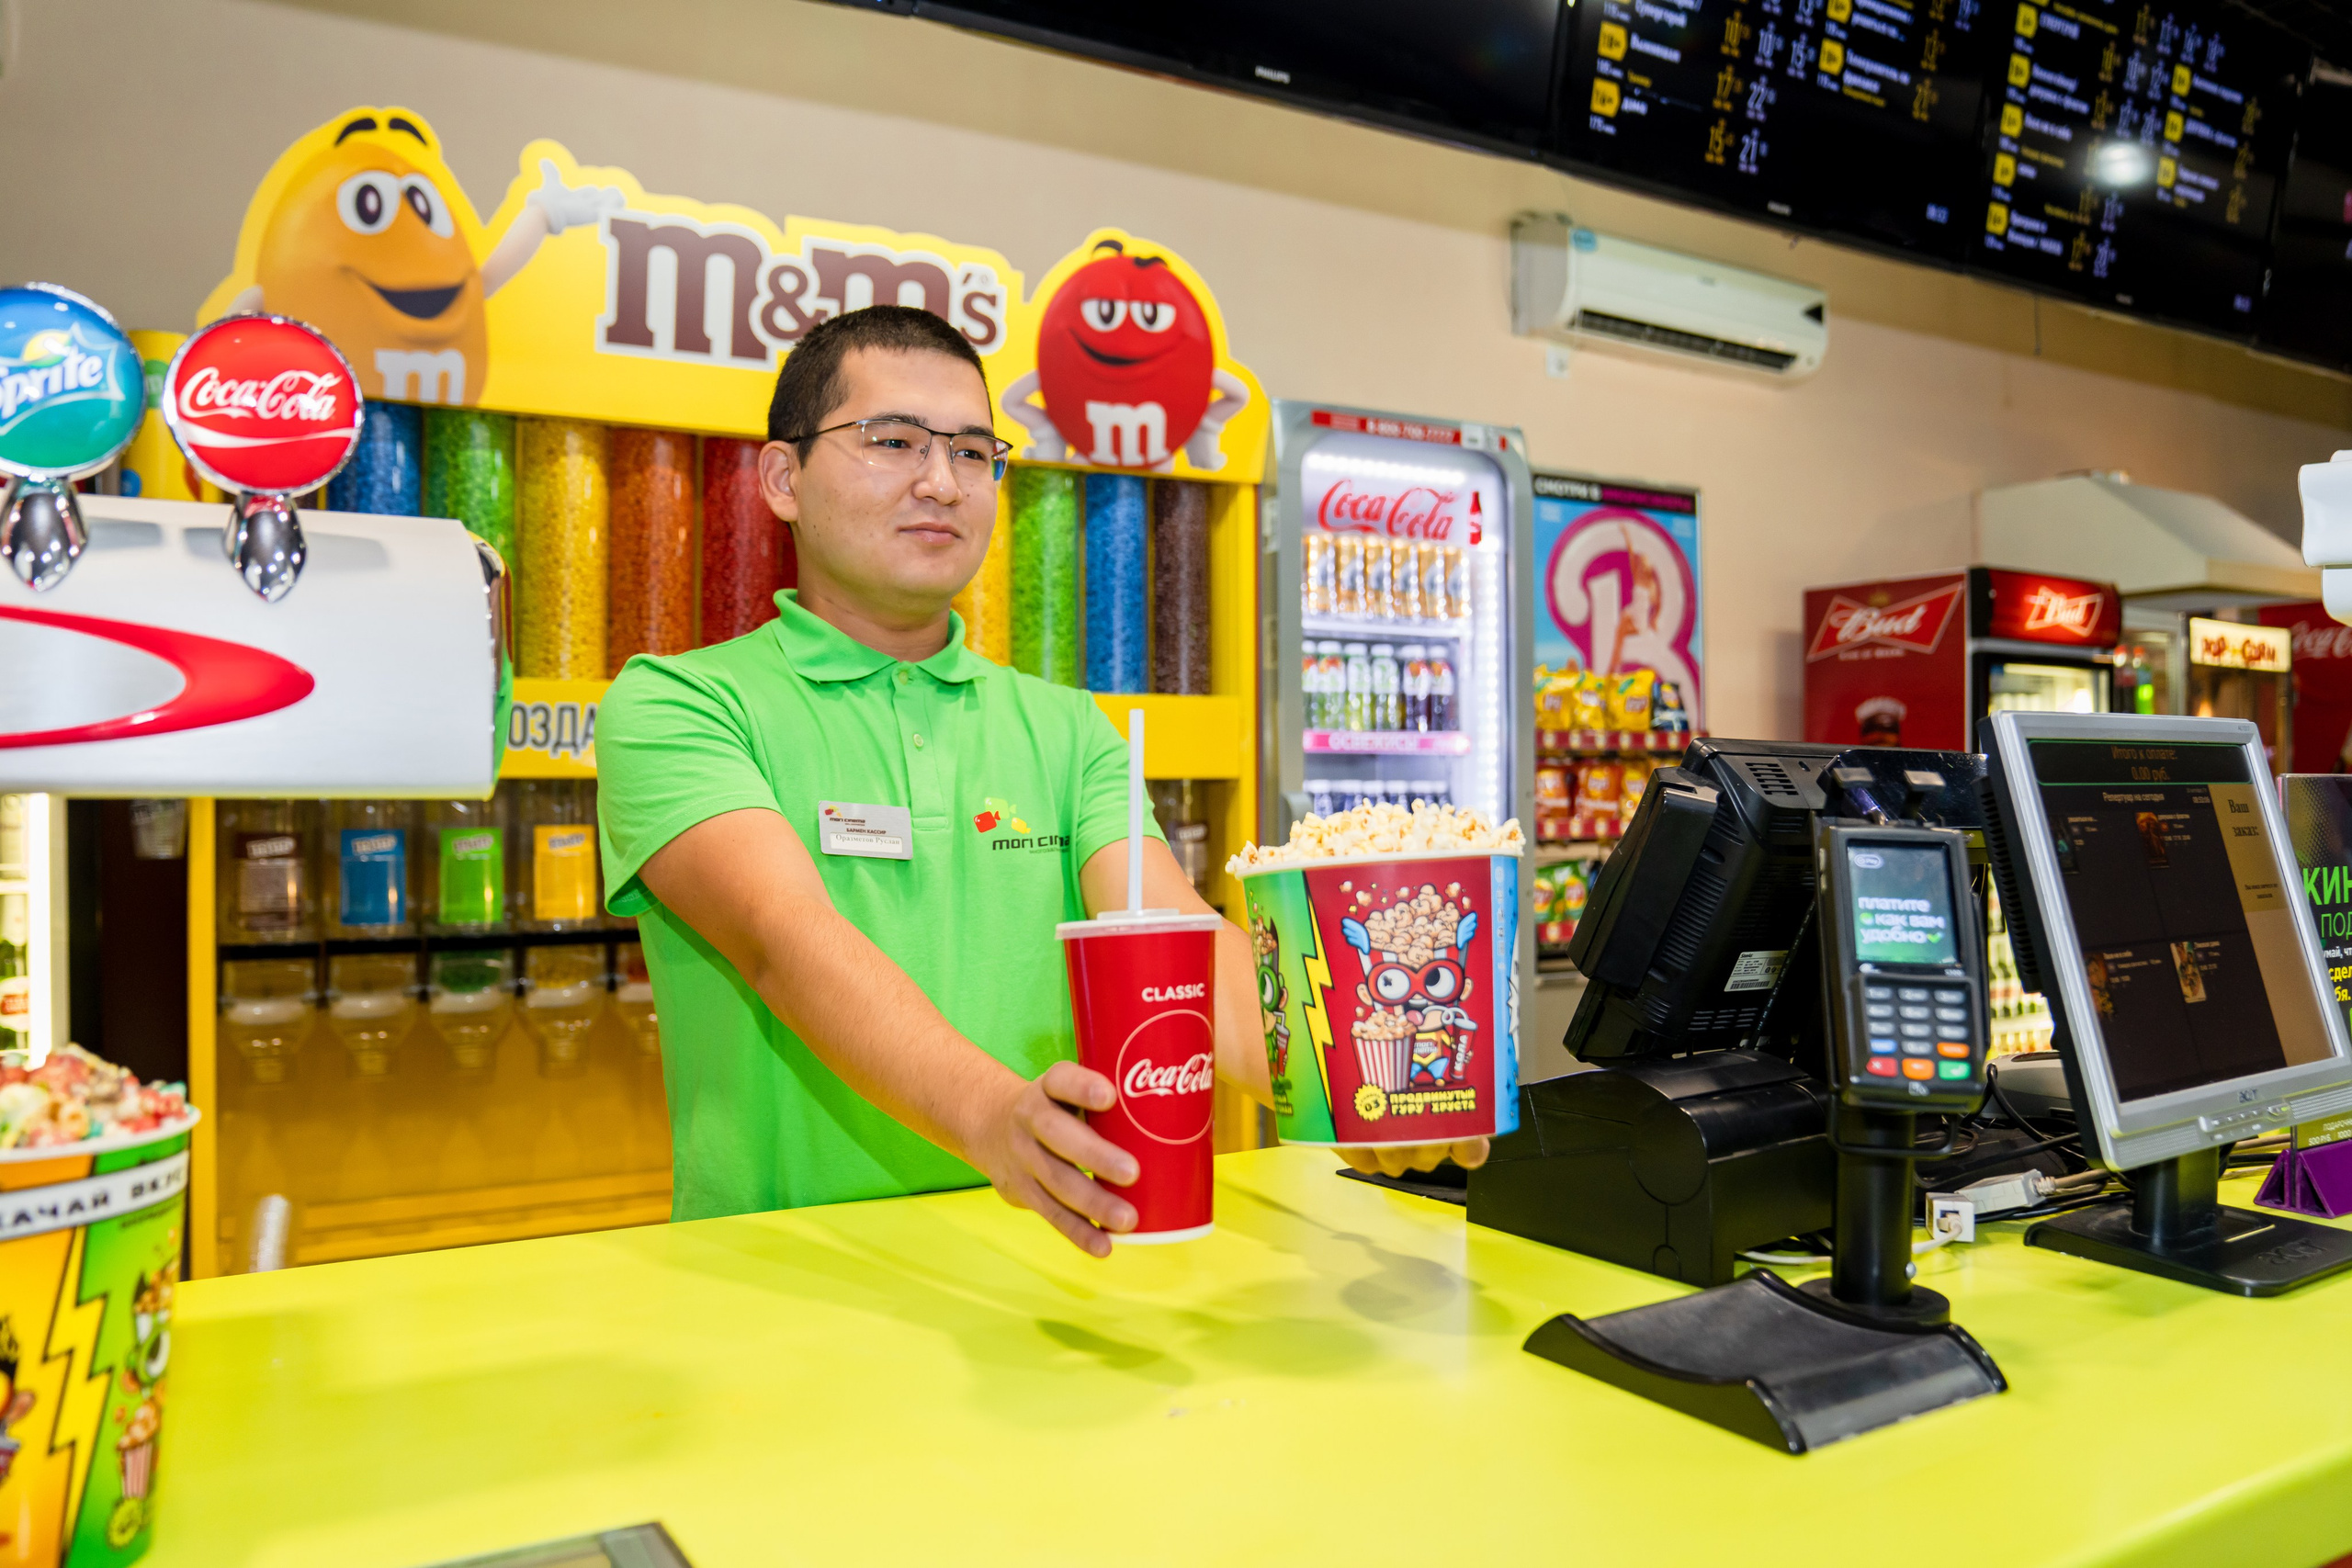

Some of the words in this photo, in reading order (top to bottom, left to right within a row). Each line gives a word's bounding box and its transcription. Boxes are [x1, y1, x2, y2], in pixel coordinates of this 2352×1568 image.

[0, 347, 104, 419] prite
[180, 367, 344, 422] Coca-Cola
[1318, 479, 1458, 541] Coca-Cola
[1828, 604, 1928, 643] Bud
[992, 839, 1034, 851] mori
[1857, 897, 1931, 913] платите
[1874, 913, 1908, 927] как
[1908, 915, 1947, 929] вам
[1860, 924, 1928, 944] удобно
[1141, 983, 1206, 1003] CLASSIC
[1124, 1052, 1214, 1099] Coca-Cola
[1389, 1088, 1476, 1104] ПРОДВИНУТЫЙ
[1391, 1101, 1425, 1116] ГУРУ
[1430, 1100, 1476, 1113] ХРУСТА
